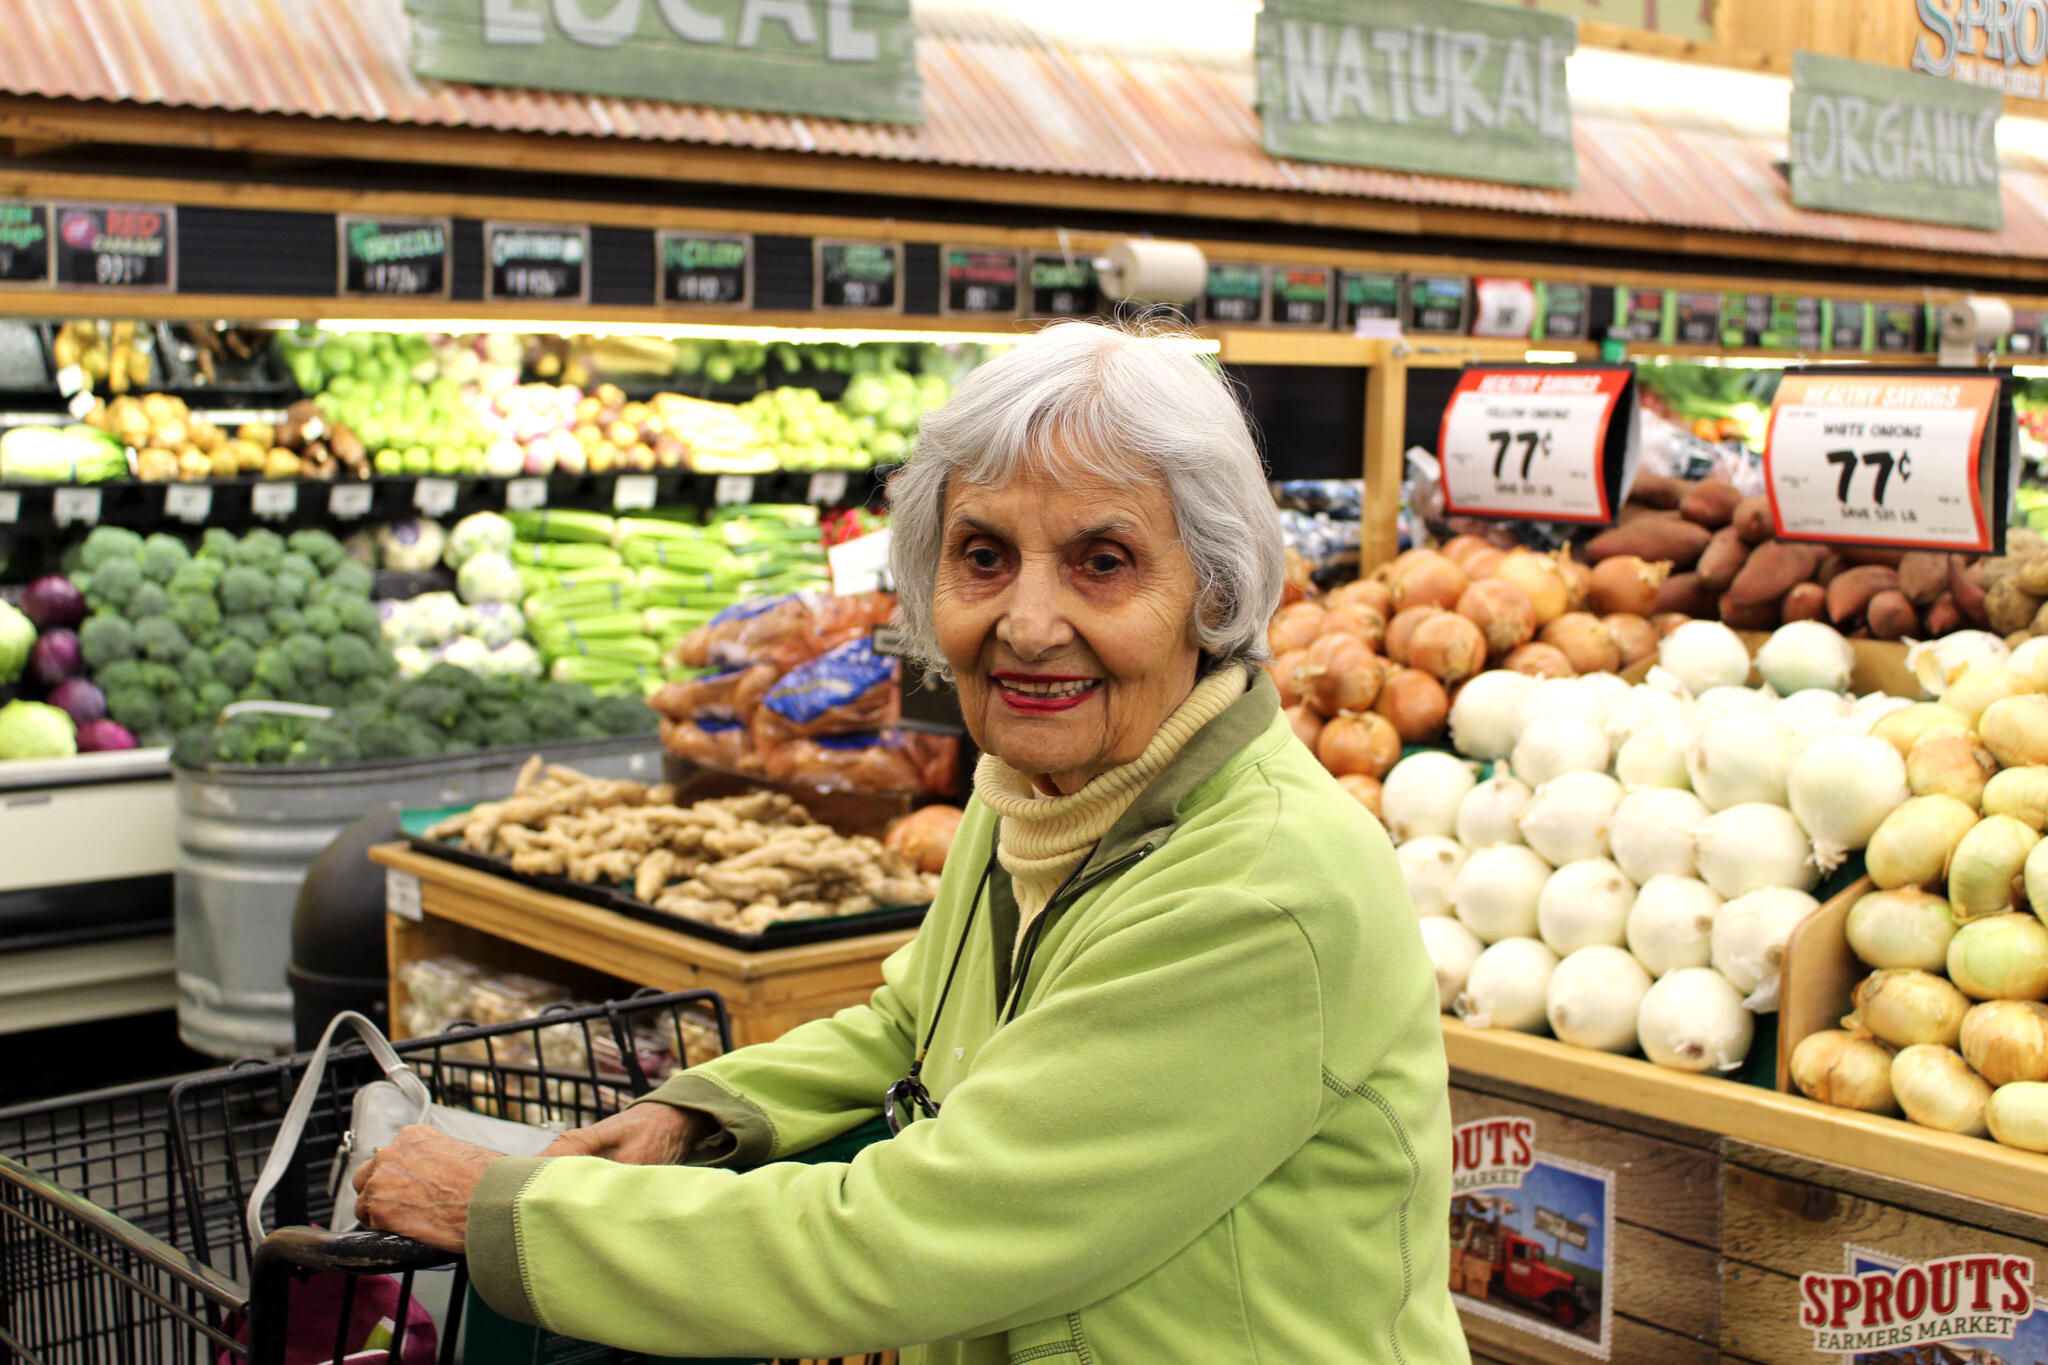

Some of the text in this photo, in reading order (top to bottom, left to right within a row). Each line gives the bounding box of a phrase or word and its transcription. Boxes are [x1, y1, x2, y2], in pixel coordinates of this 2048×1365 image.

[1912, 0, 2048, 77] SPRO
[1283, 22, 1566, 138] NATURAL
[1803, 95, 1996, 187] ORGANIC
[1803, 384, 1961, 408] HEALTHY SAVINGS
[1824, 423, 1923, 439] WHITE ONIONS
[1803, 1257, 2031, 1329] SPROUTS
[1818, 1315, 2013, 1350] FARMERS MARKET
